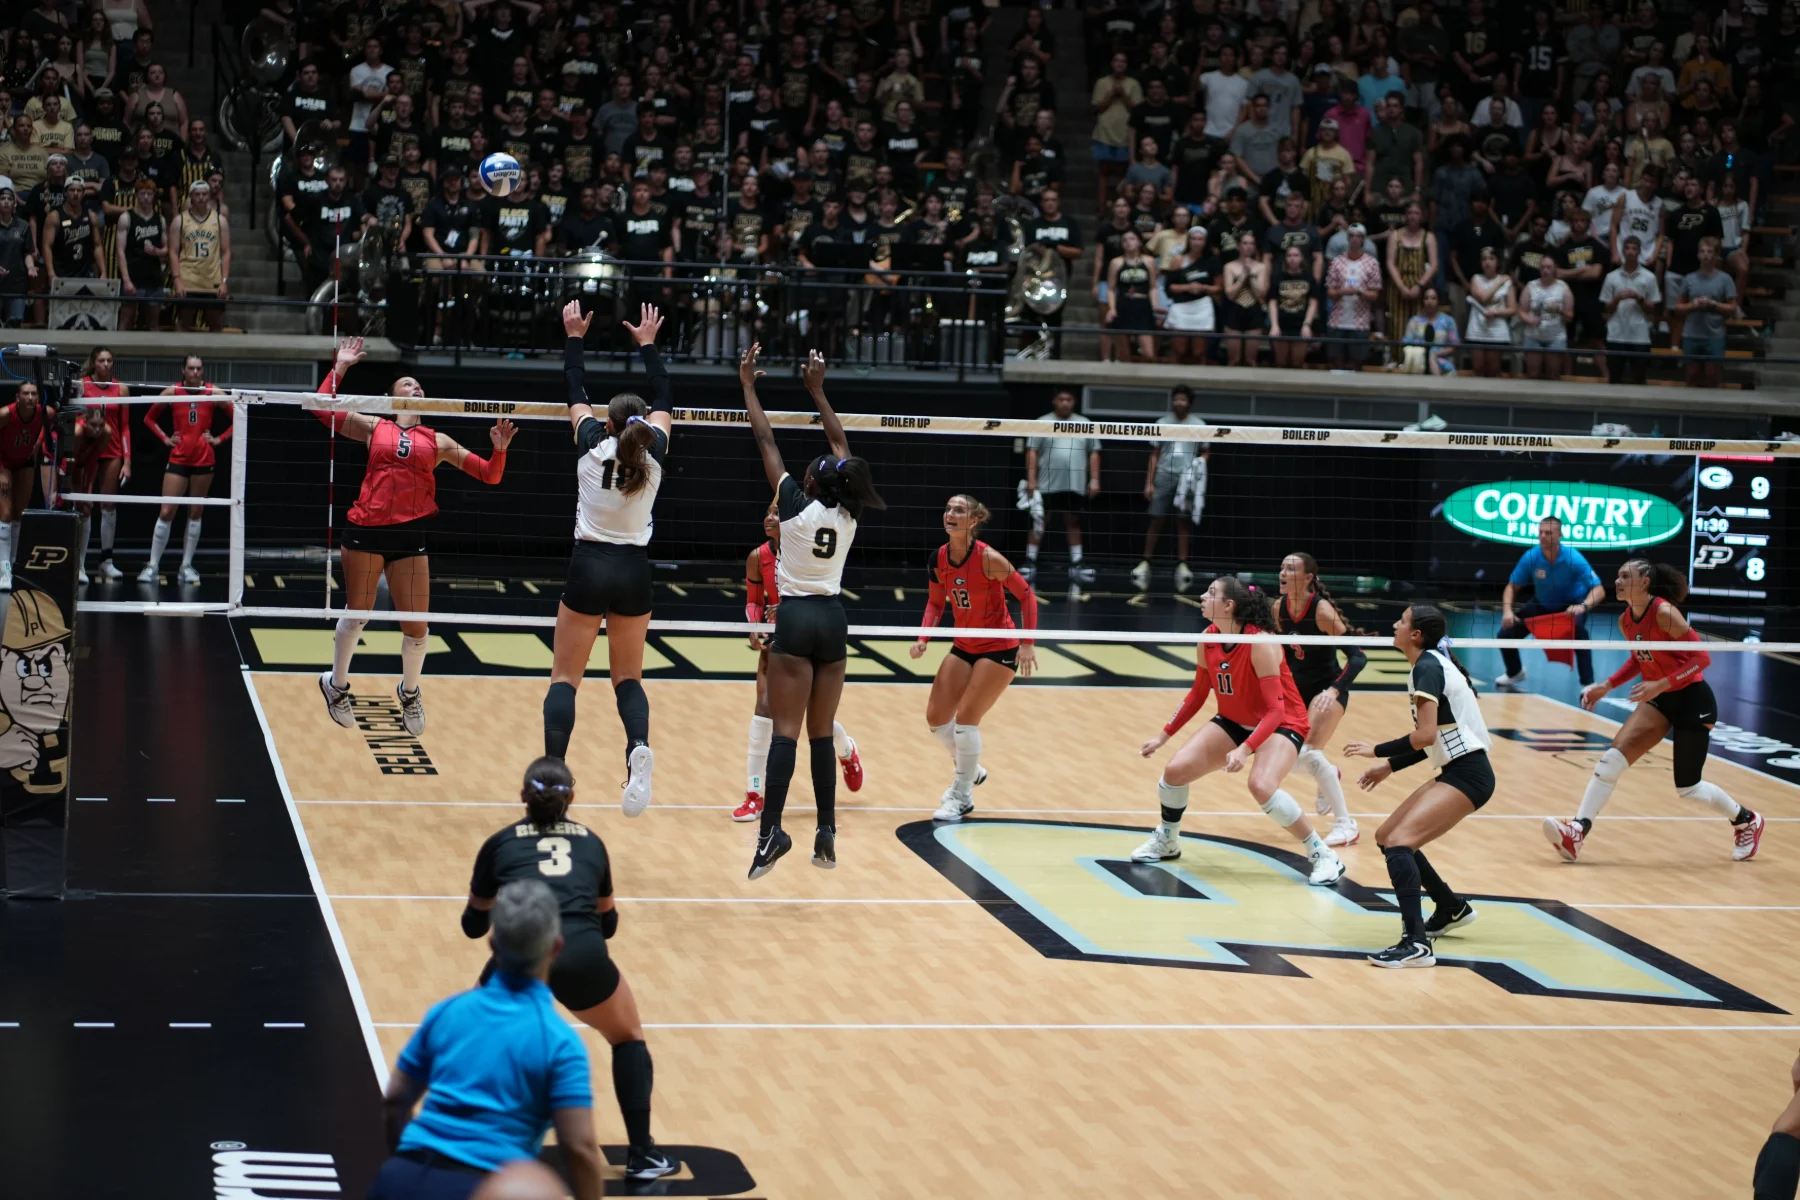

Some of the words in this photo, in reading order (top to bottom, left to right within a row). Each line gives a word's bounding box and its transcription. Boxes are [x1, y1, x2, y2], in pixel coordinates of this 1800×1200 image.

[1527, 45, 1553, 72] 15
[73, 243, 83, 260] 3
[194, 242, 209, 257] 15
[464, 402, 500, 413] BOILER
[502, 403, 515, 413] UP
[189, 410, 198, 425] 8
[691, 409, 751, 423] VOLLEYBAL
[881, 416, 916, 428] BOILER
[917, 417, 930, 428] UP
[1053, 422, 1095, 434] PURDUE
[1099, 424, 1162, 436] VOLLEYBALL
[1282, 429, 1316, 441] BOILER
[1317, 431, 1330, 441] UP
[1448, 434, 1488, 446] PURDUE
[1493, 435, 1553, 447] VOLLEYBALL
[1669, 440, 1701, 450] BOILER
[1702, 441, 1715, 451] UP
[396, 439, 412, 459] 5
[1751, 476, 1770, 500] 9
[1474, 489, 1653, 528] COUNTRY
[1507, 522, 1618, 541] FINNCIAL
[1695, 517, 1729, 533] 1:30
[812, 527, 838, 560] 9
[1746, 557, 1765, 581] 8
[951, 588, 972, 609] 12
[30, 622, 39, 636] P
[1675, 664, 1700, 681] BULLDOGS
[1216, 673, 1234, 695] 11
[515, 822, 588, 838] BOLERS
[537, 837, 572, 876] 3
